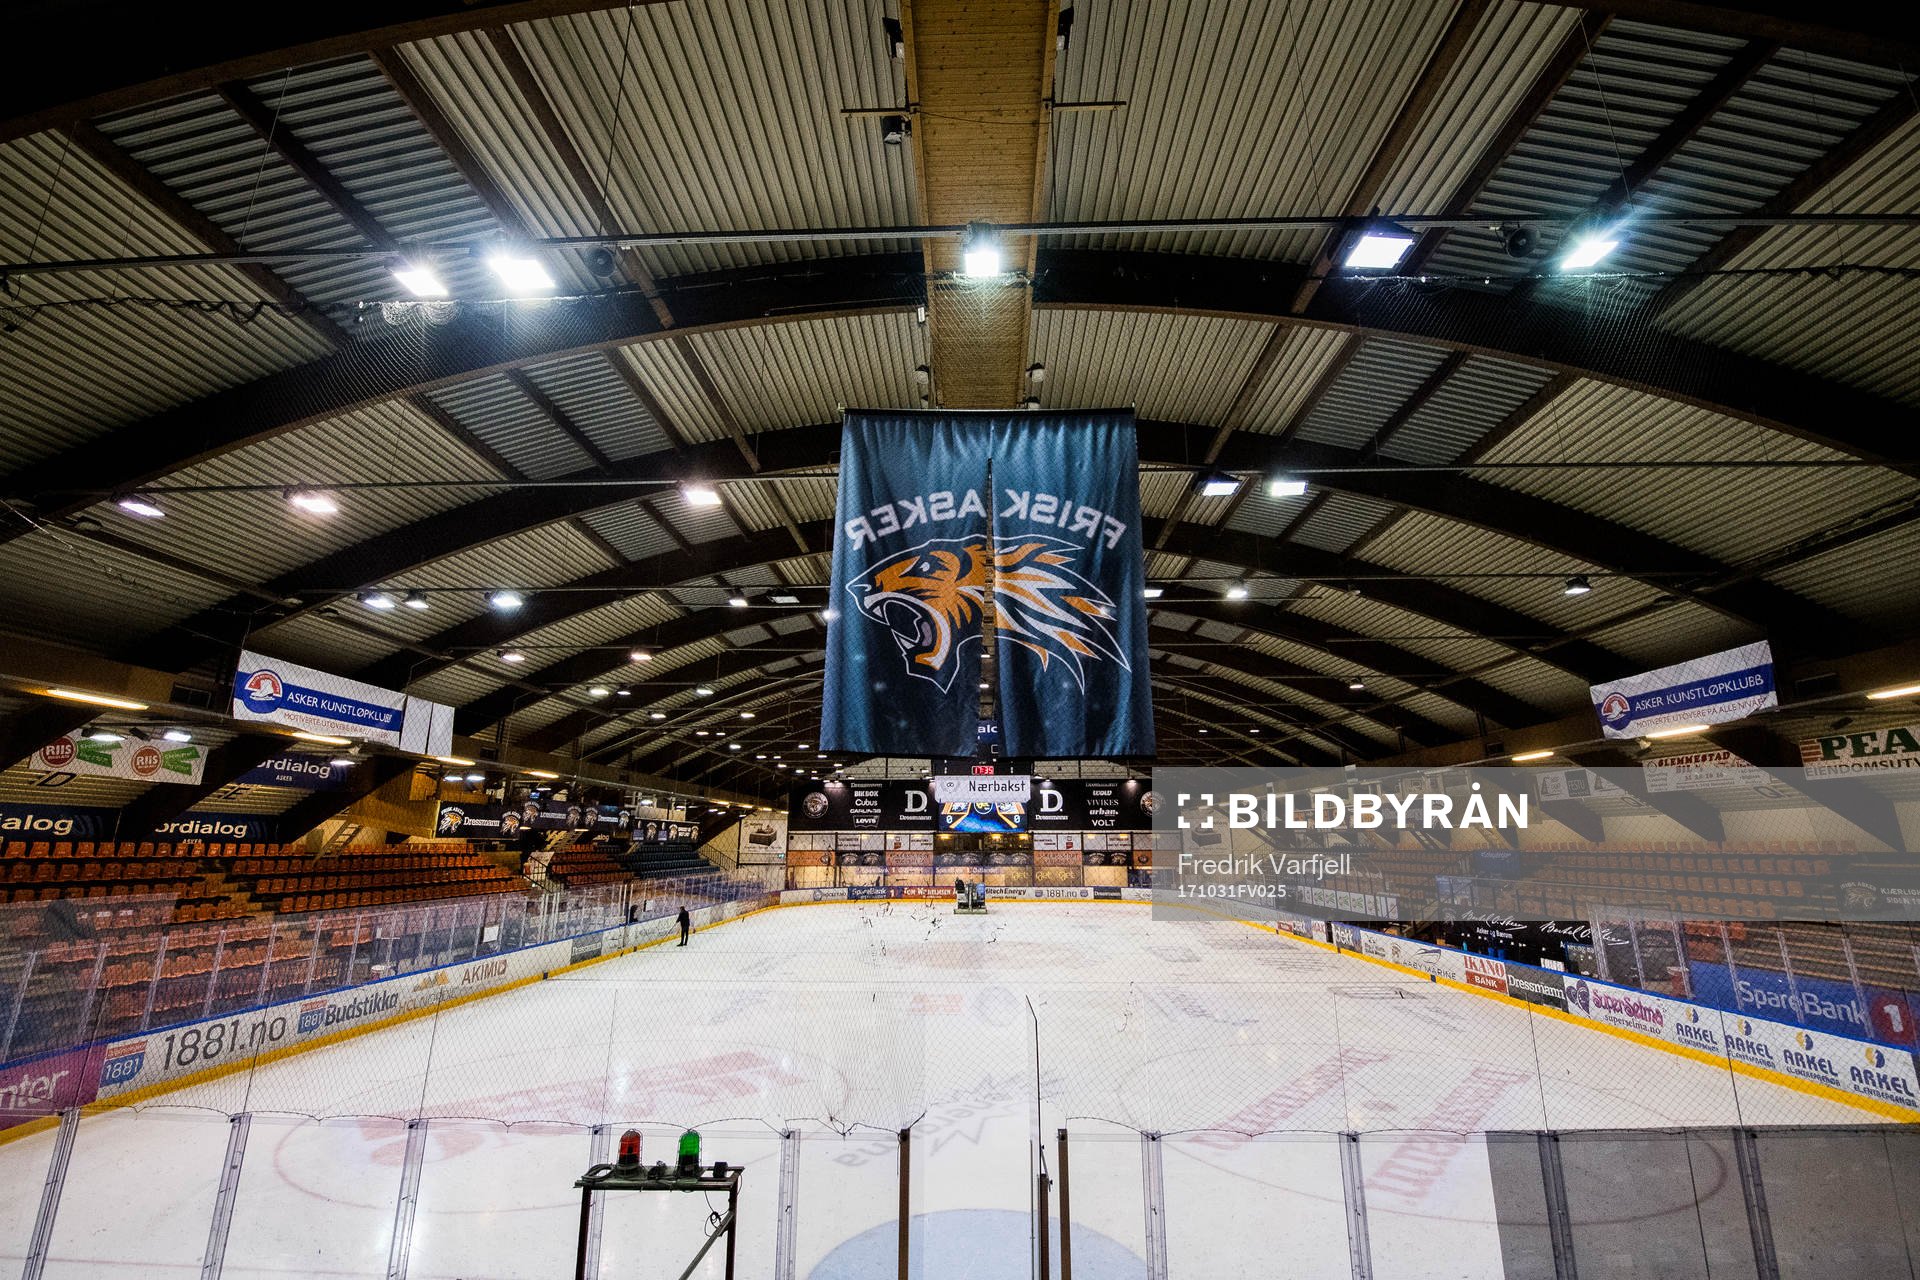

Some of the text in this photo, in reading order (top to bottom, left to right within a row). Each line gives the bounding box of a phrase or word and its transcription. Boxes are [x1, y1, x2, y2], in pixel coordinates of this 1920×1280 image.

[286, 691, 319, 708] ASKER
[1634, 674, 1765, 713] ASKER KUNSTLØPKLUBB
[45, 742, 73, 756] RIIS
[136, 754, 159, 766] RIIS
[257, 758, 331, 779] rdialog
[968, 780, 1026, 792] Nærbakst
[855, 799, 878, 807] Cubus
[1046, 889, 1078, 898] 1881.no
[1463, 955, 1505, 978] IKANO
[1474, 977, 1498, 989] BANK
[1508, 974, 1566, 1000] Dressmann
[325, 991, 399, 1026] Budstikka
[1736, 980, 1904, 1033] SpareBank 1
[301, 1011, 325, 1028] 1881
[1604, 1013, 1662, 1036] superselma.no
[164, 1016, 287, 1071] 1881.no
[1676, 1022, 1718, 1046] ARKEL
[1726, 1034, 1774, 1060] ARKEL
[105, 1057, 140, 1080] 1881
[1783, 1049, 1839, 1078] ARKEL
[1850, 1066, 1915, 1097] ARKEL
